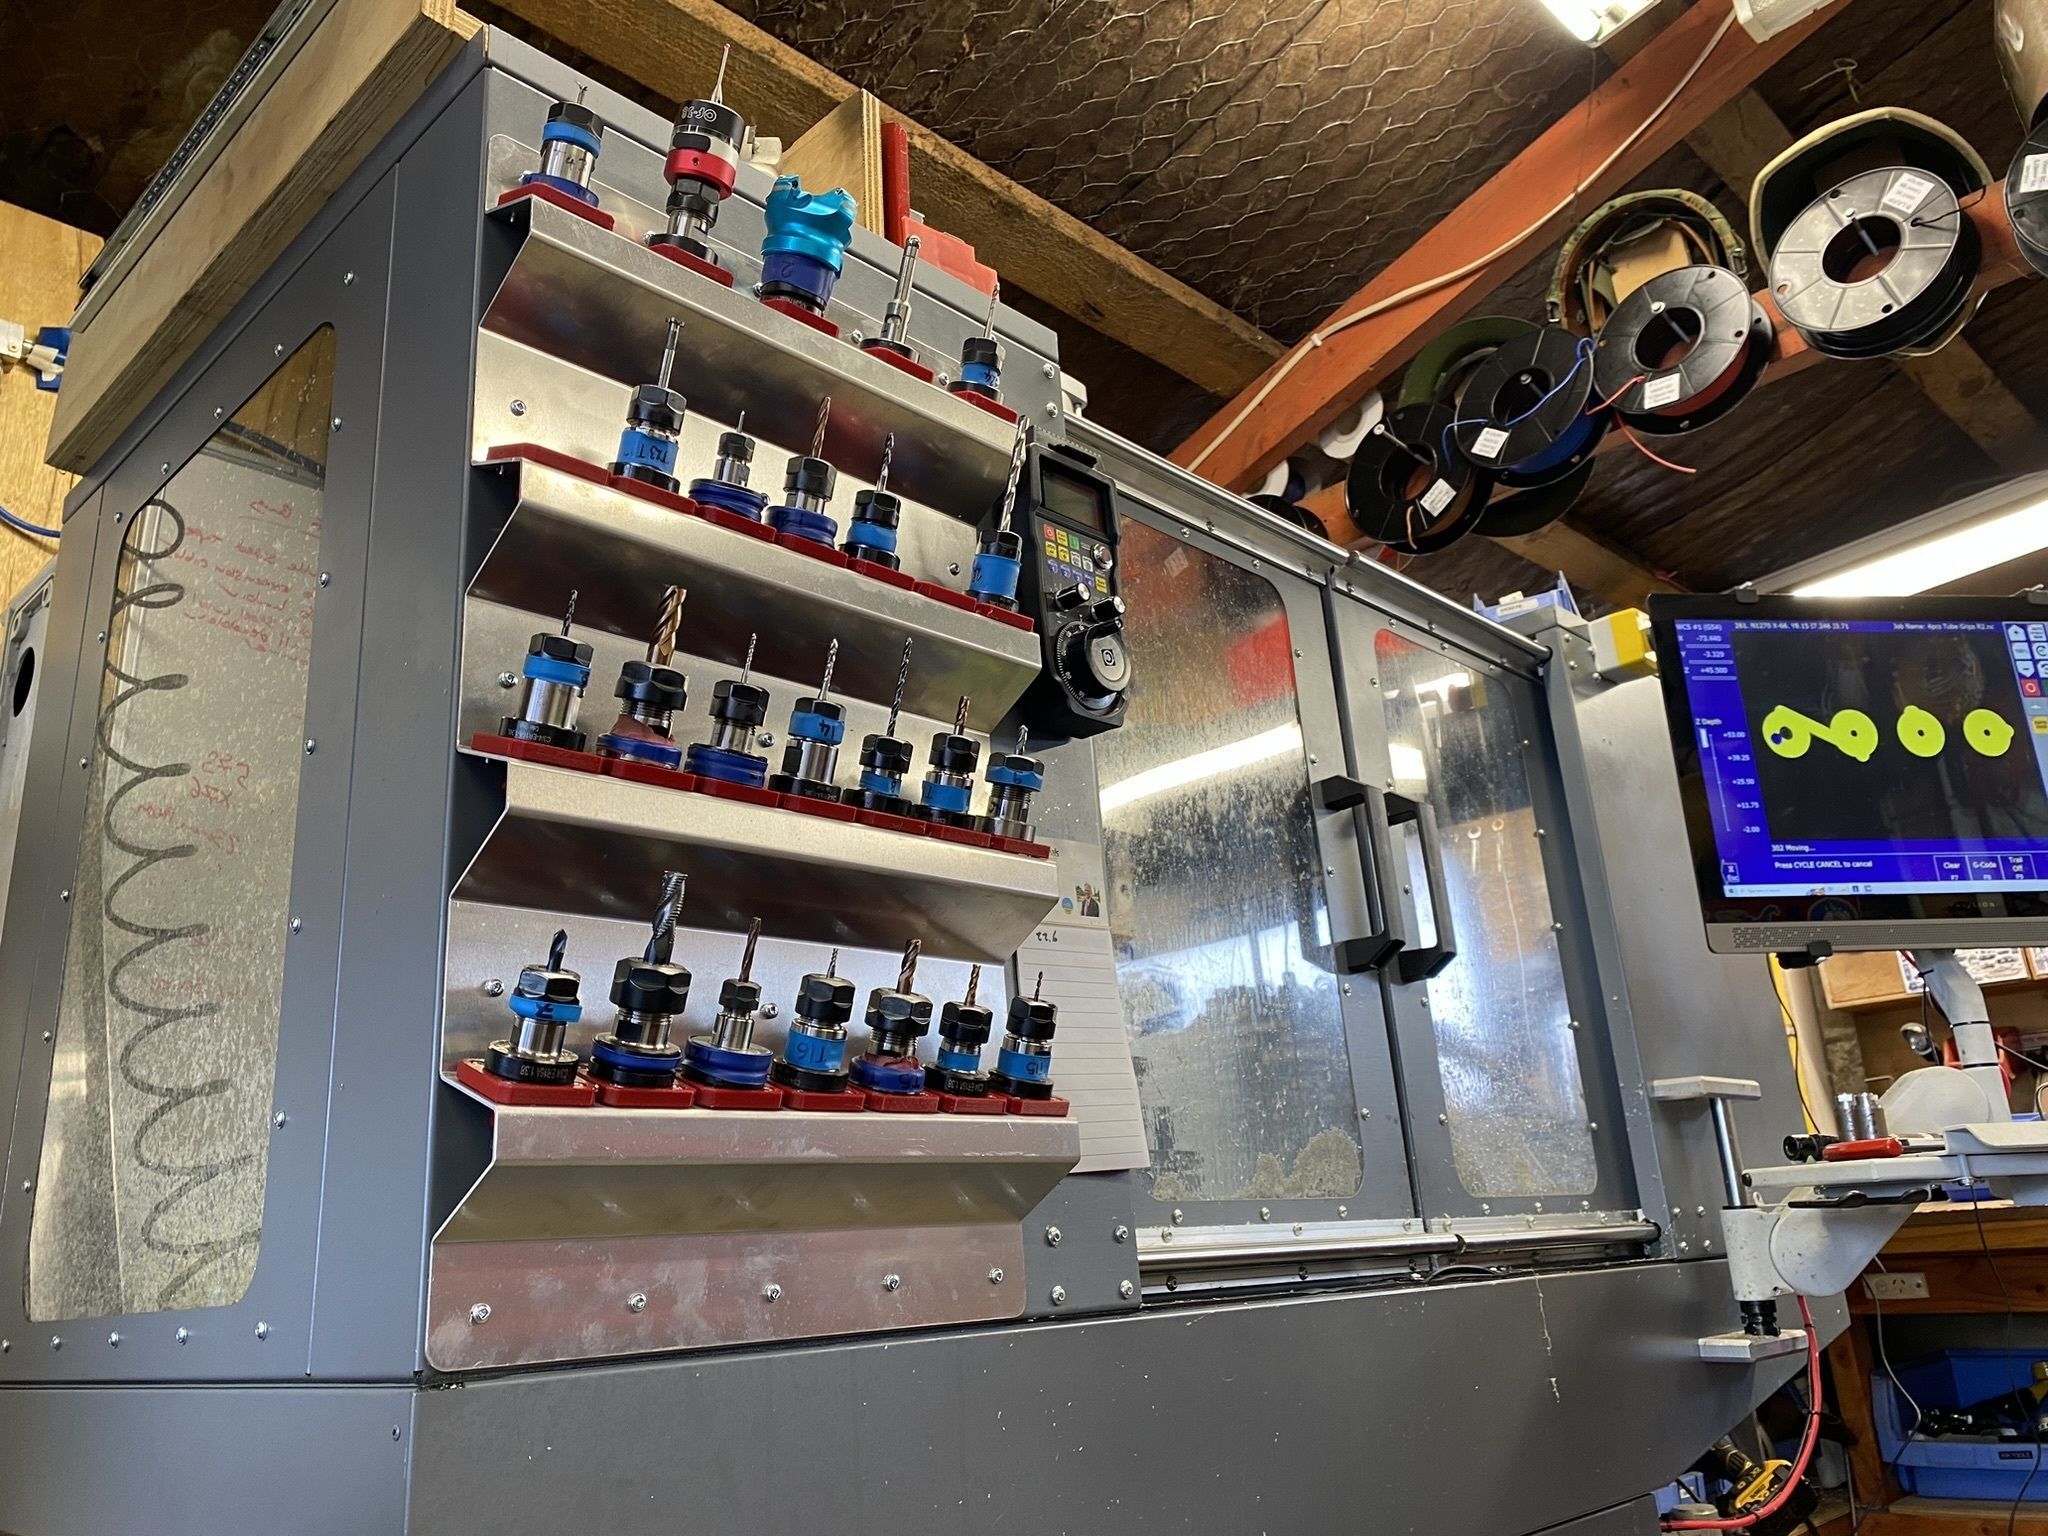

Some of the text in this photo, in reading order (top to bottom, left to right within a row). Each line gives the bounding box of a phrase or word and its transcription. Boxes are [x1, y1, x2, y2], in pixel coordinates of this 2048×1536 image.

[1701, 718, 1722, 727] Depth
[818, 720, 836, 740] 14
[1736, 801, 1760, 809] +11.75
[1742, 825, 1761, 833] -2.00
[1771, 844, 1784, 852] 302
[1774, 861, 1793, 869] Press
[1793, 861, 1815, 869] CYCLE
[1816, 860, 1843, 869] CANCEL
[1851, 860, 1873, 868] cancel
[1943, 861, 1961, 869] Clear
[1972, 861, 1998, 869] G-Code
[519, 1064, 535, 1077] 1.38
